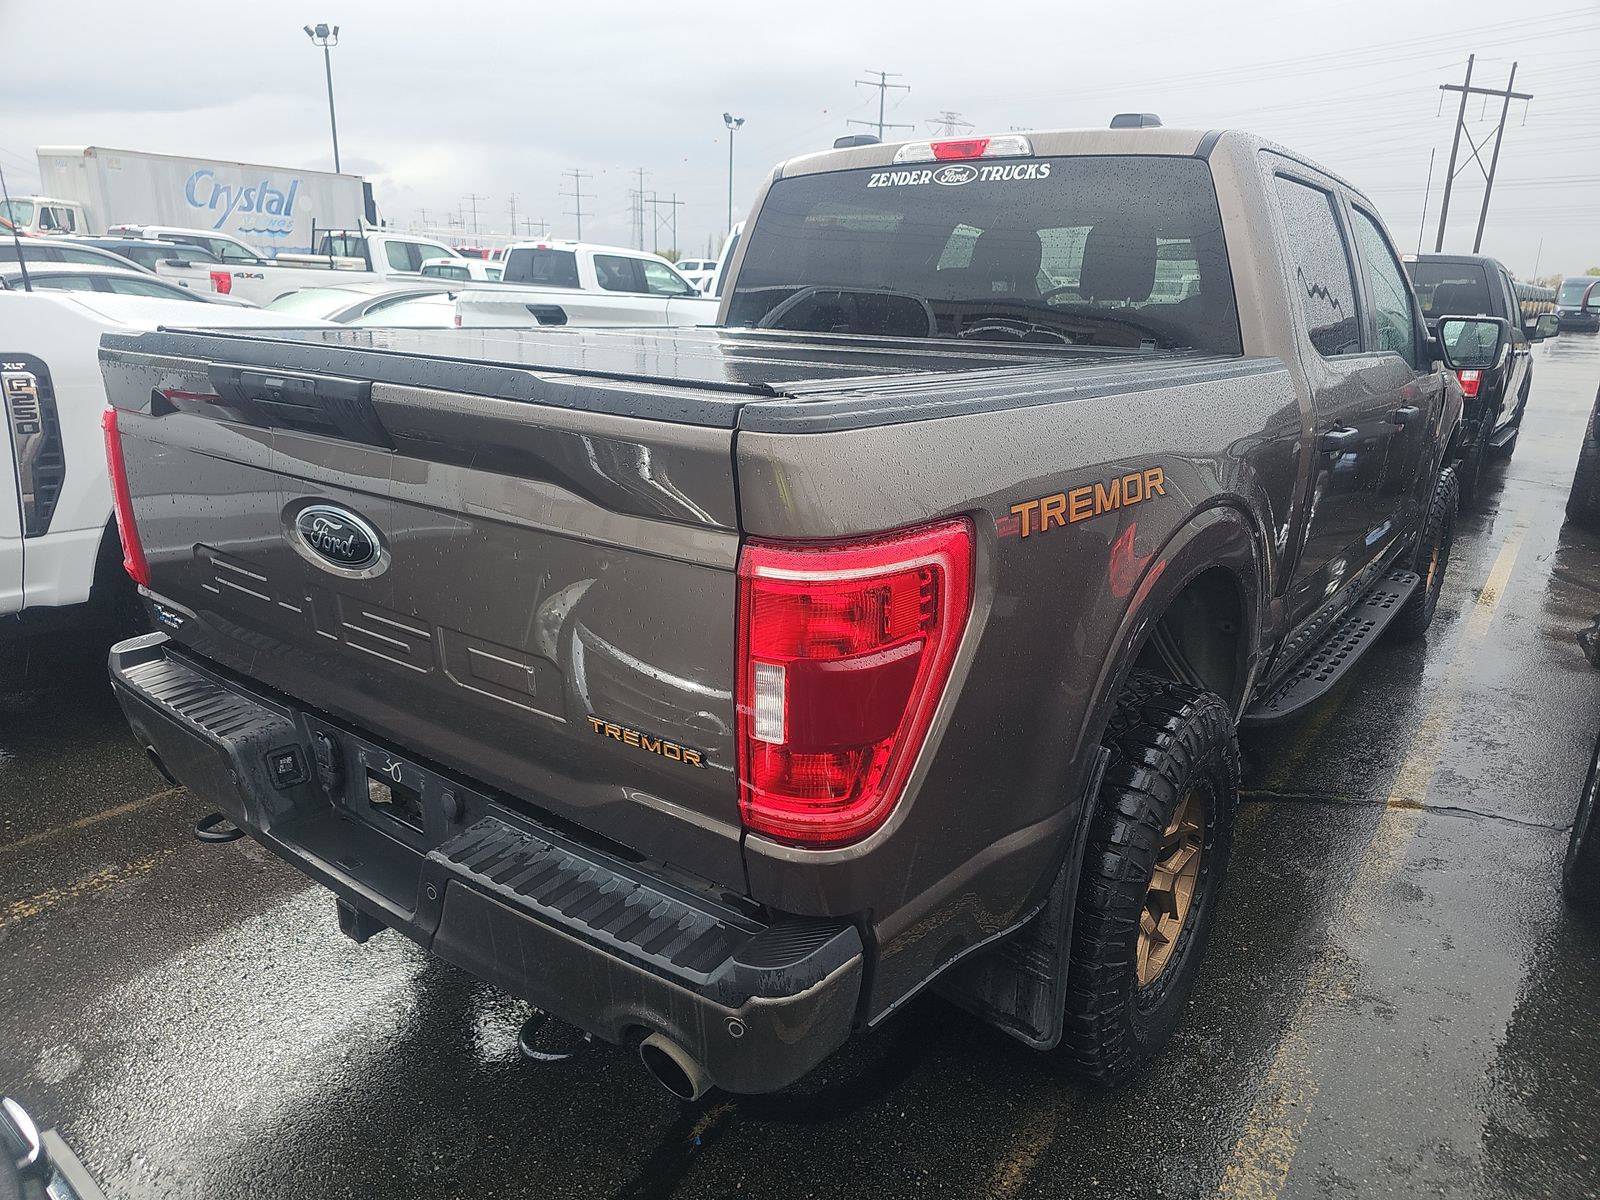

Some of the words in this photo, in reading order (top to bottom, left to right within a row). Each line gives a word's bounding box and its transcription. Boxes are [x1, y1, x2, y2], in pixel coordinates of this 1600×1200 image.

[185, 169, 299, 229] Crystal
[867, 170, 932, 188] ZENDER
[940, 168, 970, 183] Ford
[980, 163, 1050, 181] TRUCKS
[2, 362, 26, 370] XLT
[1010, 467, 1166, 538] TREMOR
[310, 516, 356, 558] Ford
[586, 715, 706, 769] TREMOR
